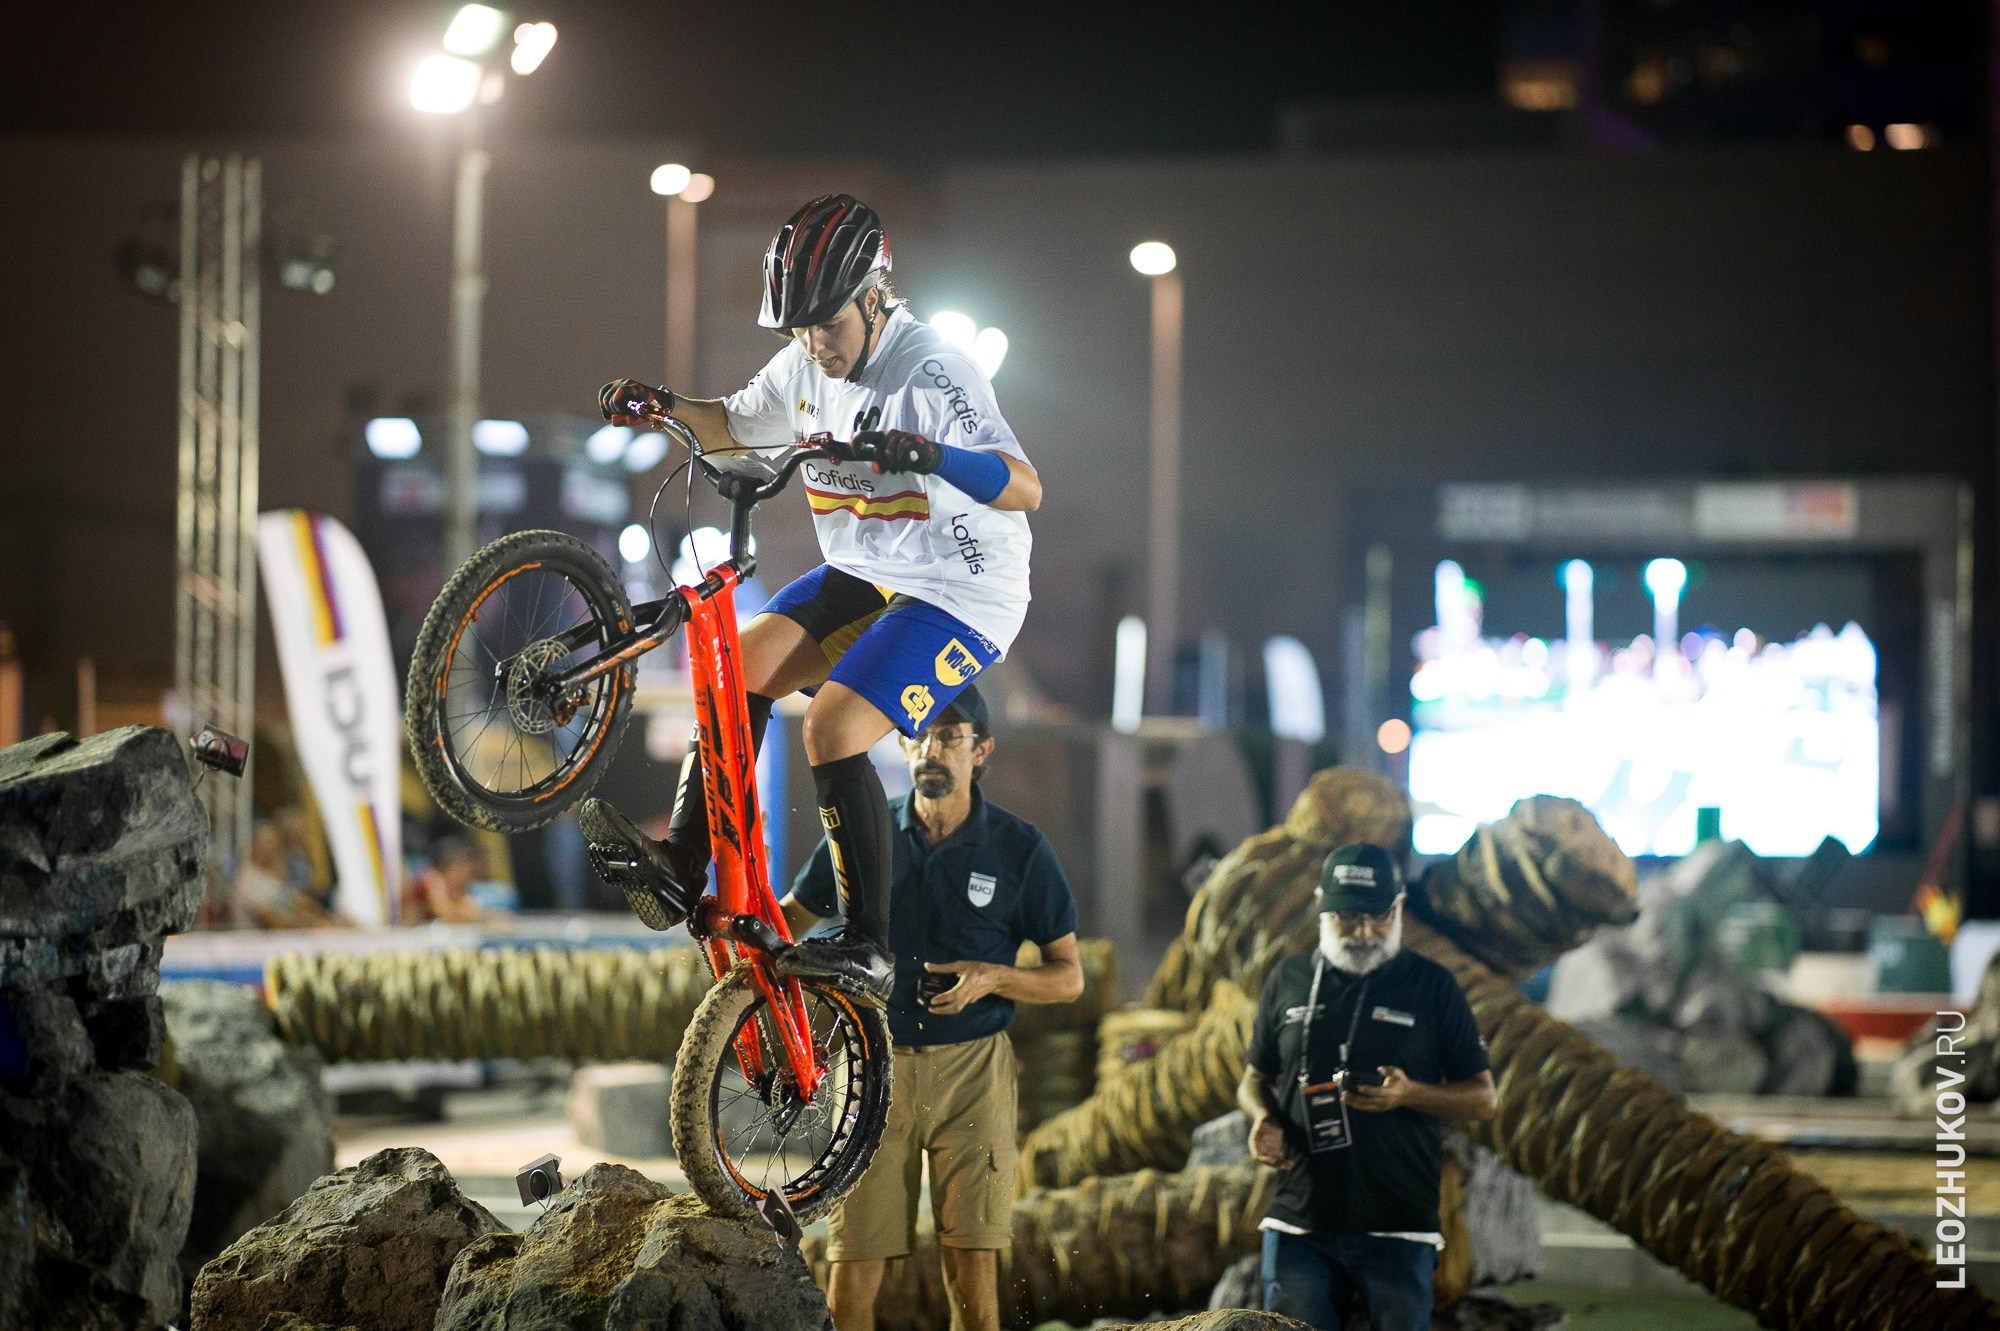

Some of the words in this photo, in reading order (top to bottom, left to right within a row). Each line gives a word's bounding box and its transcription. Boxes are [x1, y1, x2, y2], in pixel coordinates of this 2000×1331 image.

[922, 359, 978, 434] Cofidis
[805, 463, 875, 493] Cofidis
[951, 513, 985, 575] ofdis
